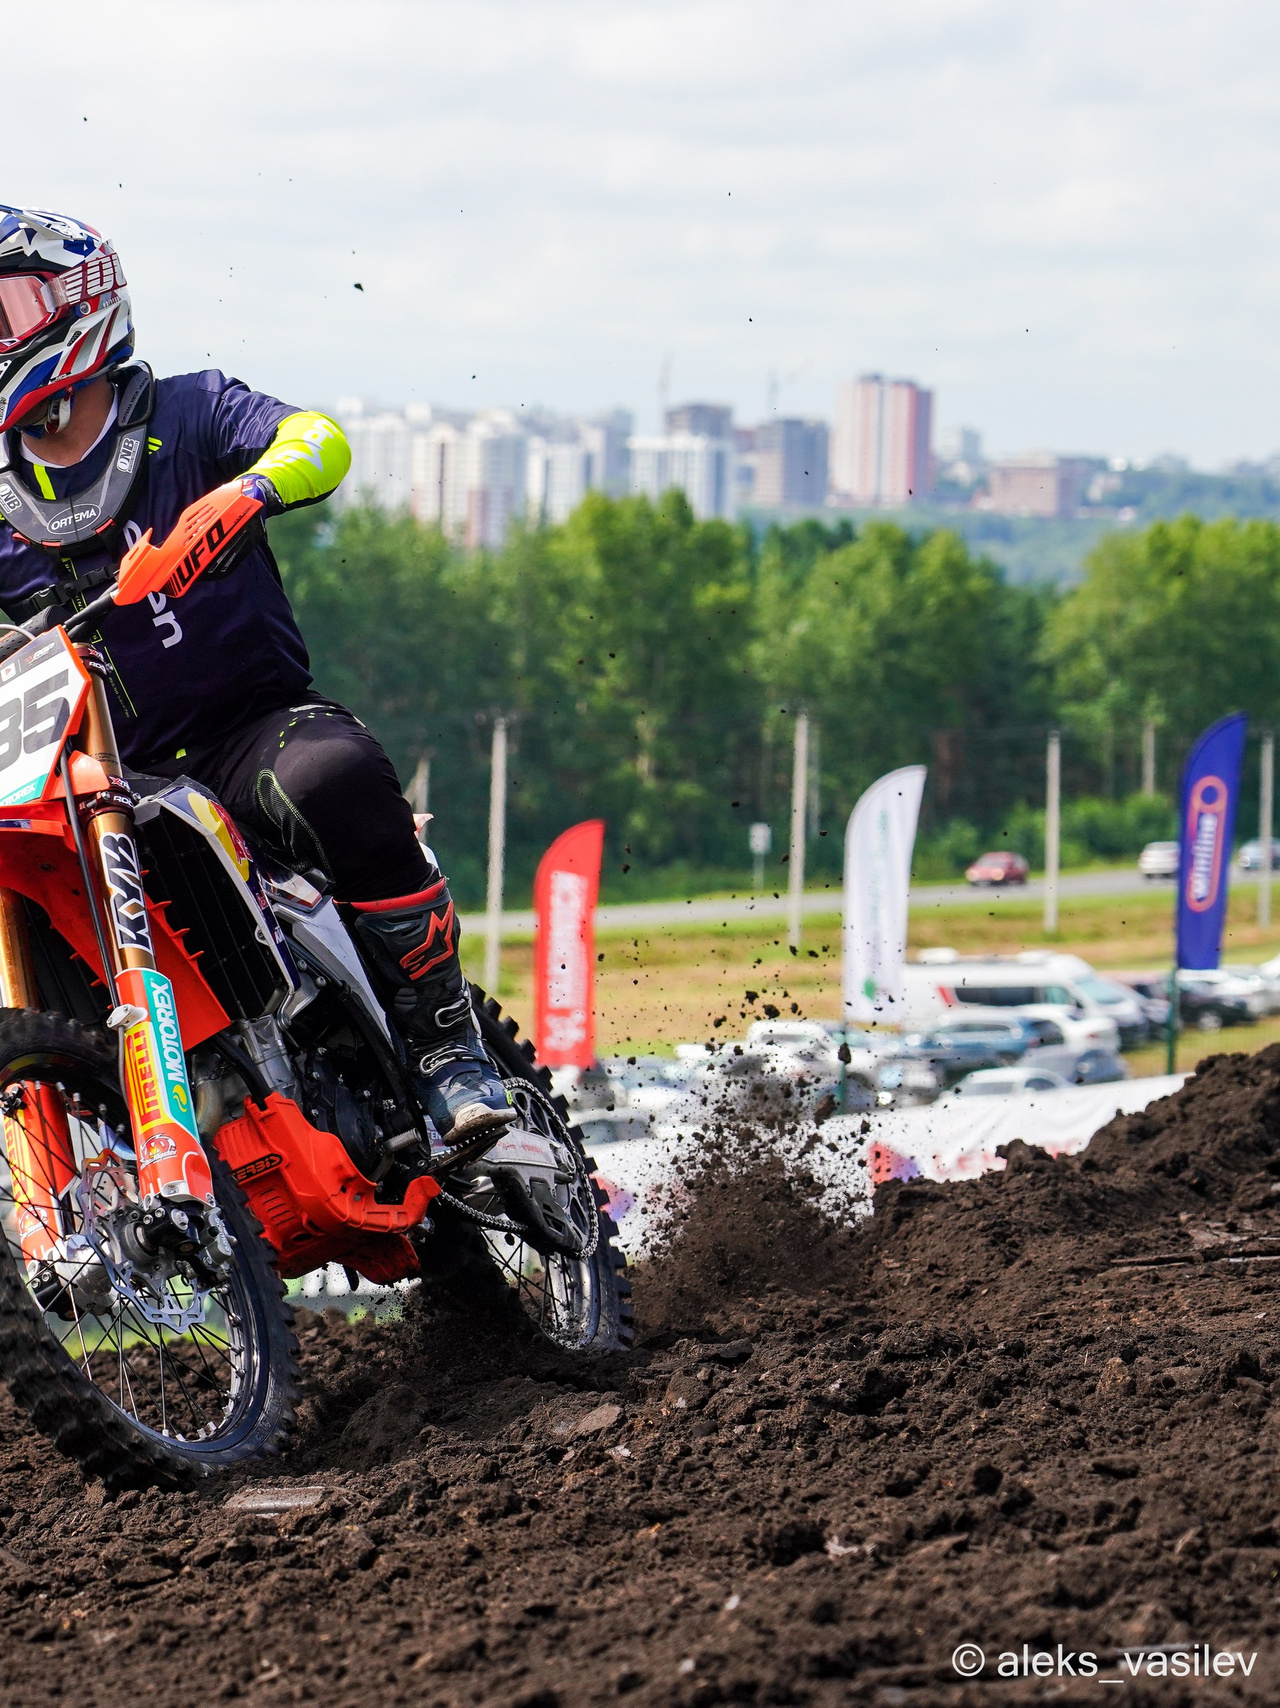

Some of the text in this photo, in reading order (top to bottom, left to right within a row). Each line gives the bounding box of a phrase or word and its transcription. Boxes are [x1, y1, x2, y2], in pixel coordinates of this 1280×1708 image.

[52, 508, 97, 531] ORTEMA
[175, 518, 225, 591] UFO
[98, 831, 155, 957] KYB
[127, 1029, 162, 1127] PIRELLI
[150, 980, 187, 1085] MOTOREX
